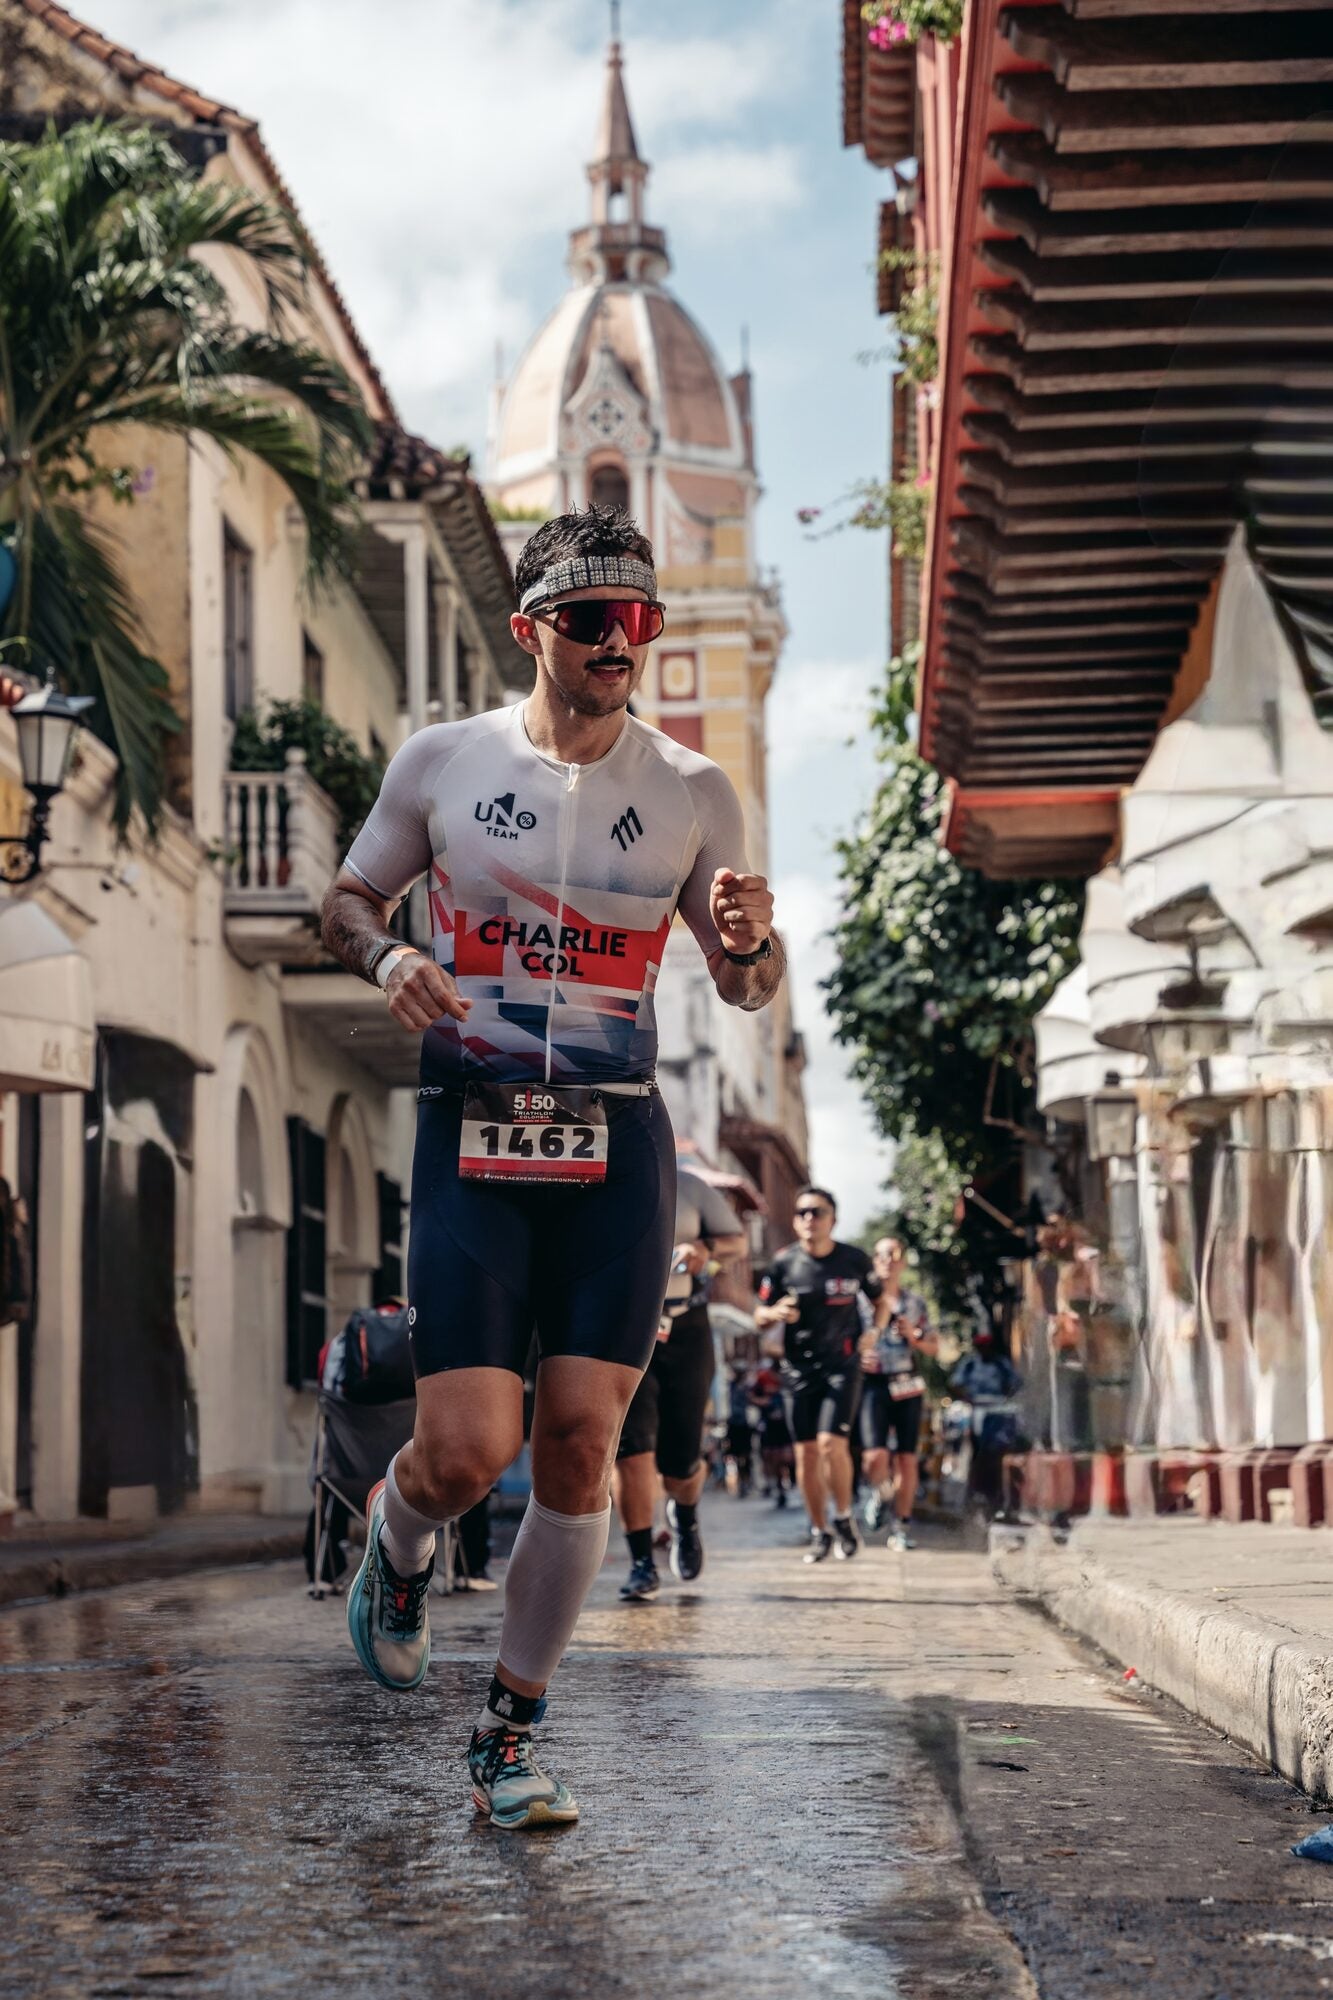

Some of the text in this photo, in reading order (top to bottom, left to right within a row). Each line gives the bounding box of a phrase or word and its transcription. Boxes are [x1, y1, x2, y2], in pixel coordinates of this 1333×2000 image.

[486, 826, 518, 841] TEAM
[478, 920, 628, 957] CHARLIE
[520, 952, 584, 976] COL
[479, 1125, 595, 1159] 1462
